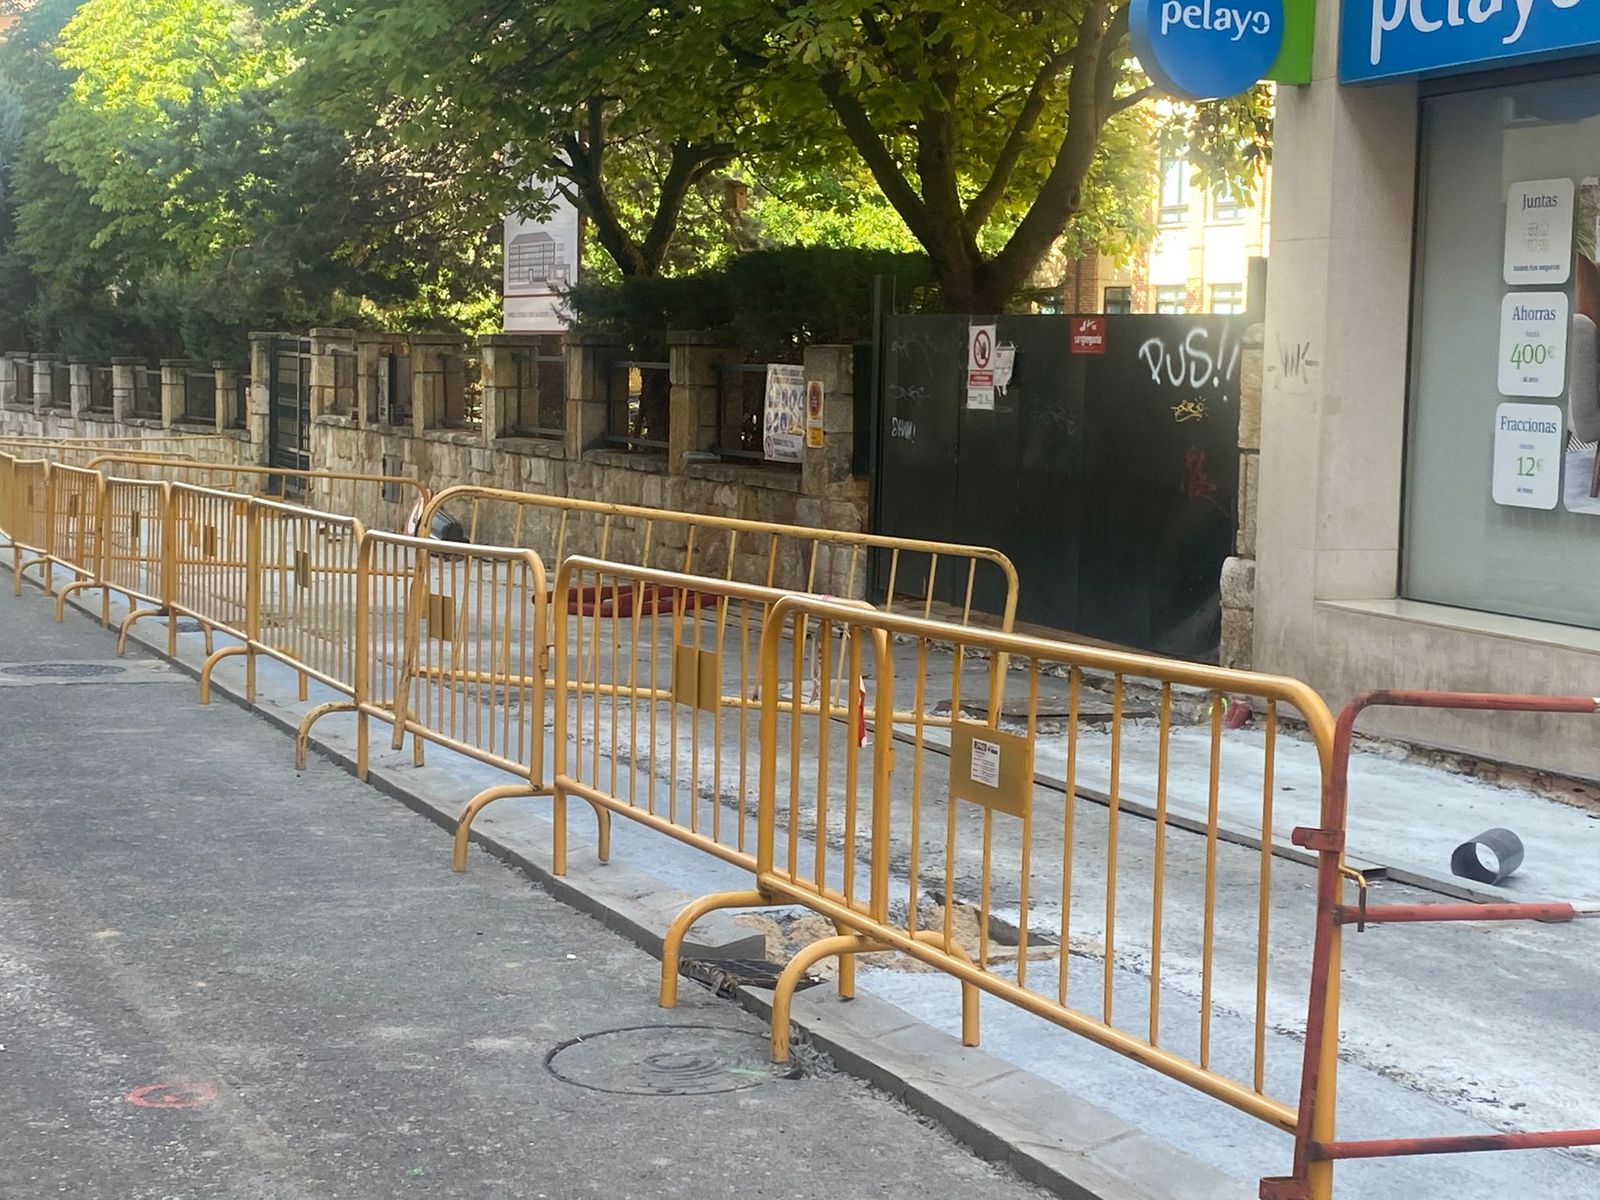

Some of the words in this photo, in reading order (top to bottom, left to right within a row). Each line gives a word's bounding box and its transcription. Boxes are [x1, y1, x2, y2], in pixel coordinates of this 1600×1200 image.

[1161, 0, 1271, 41] pelayo
[1370, 0, 1583, 66] pey
[1522, 193, 1558, 211] Juntas
[1512, 305, 1556, 321] Ahorras
[1510, 343, 1556, 370] 400€
[1500, 415, 1557, 433] Fraccionas
[1516, 456, 1544, 477] 12€
